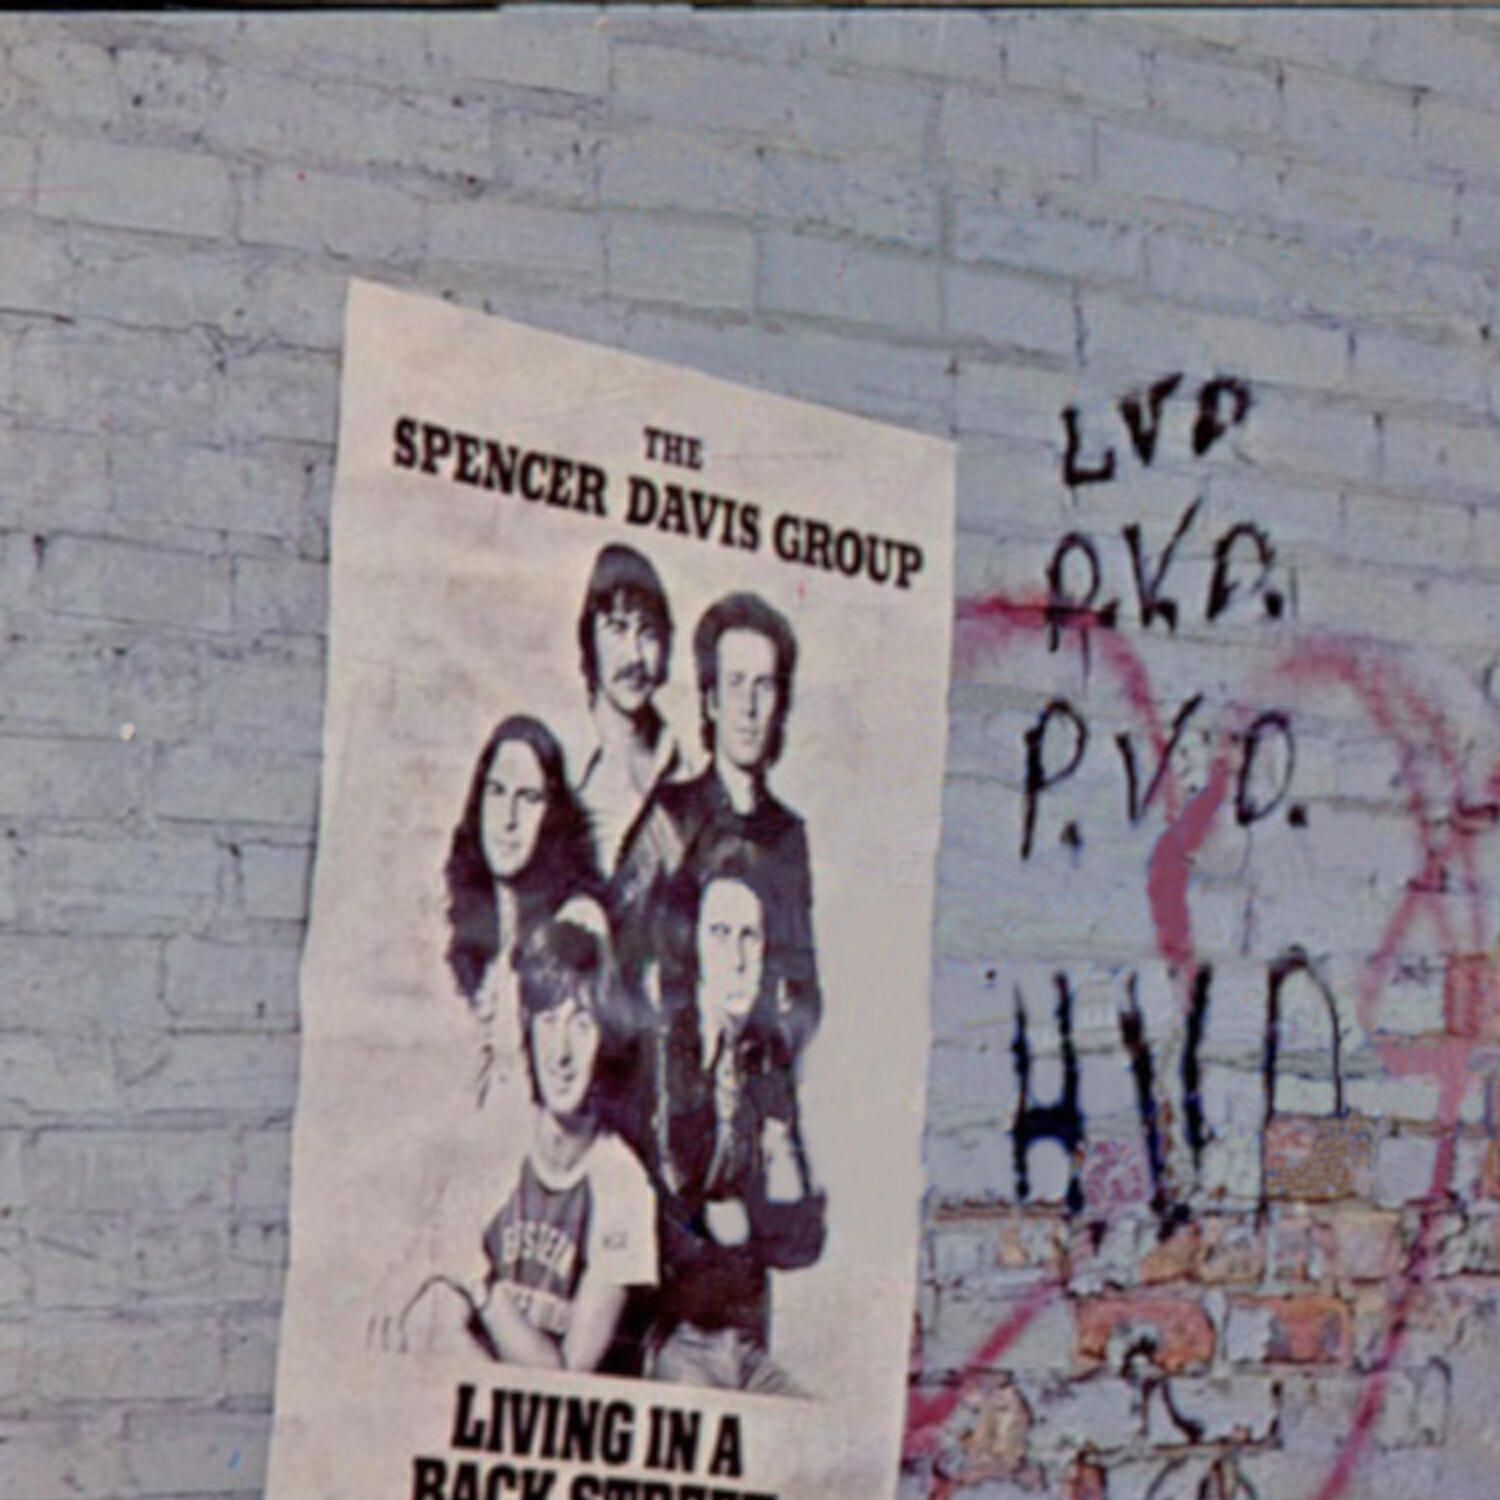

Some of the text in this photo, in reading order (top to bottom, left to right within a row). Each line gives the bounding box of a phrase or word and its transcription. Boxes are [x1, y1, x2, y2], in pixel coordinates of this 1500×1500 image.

[643, 427, 704, 470] THE
[393, 416, 924, 589] SPENCER DAVIS GROUP
[451, 1383, 743, 1478] LIVING IN A
